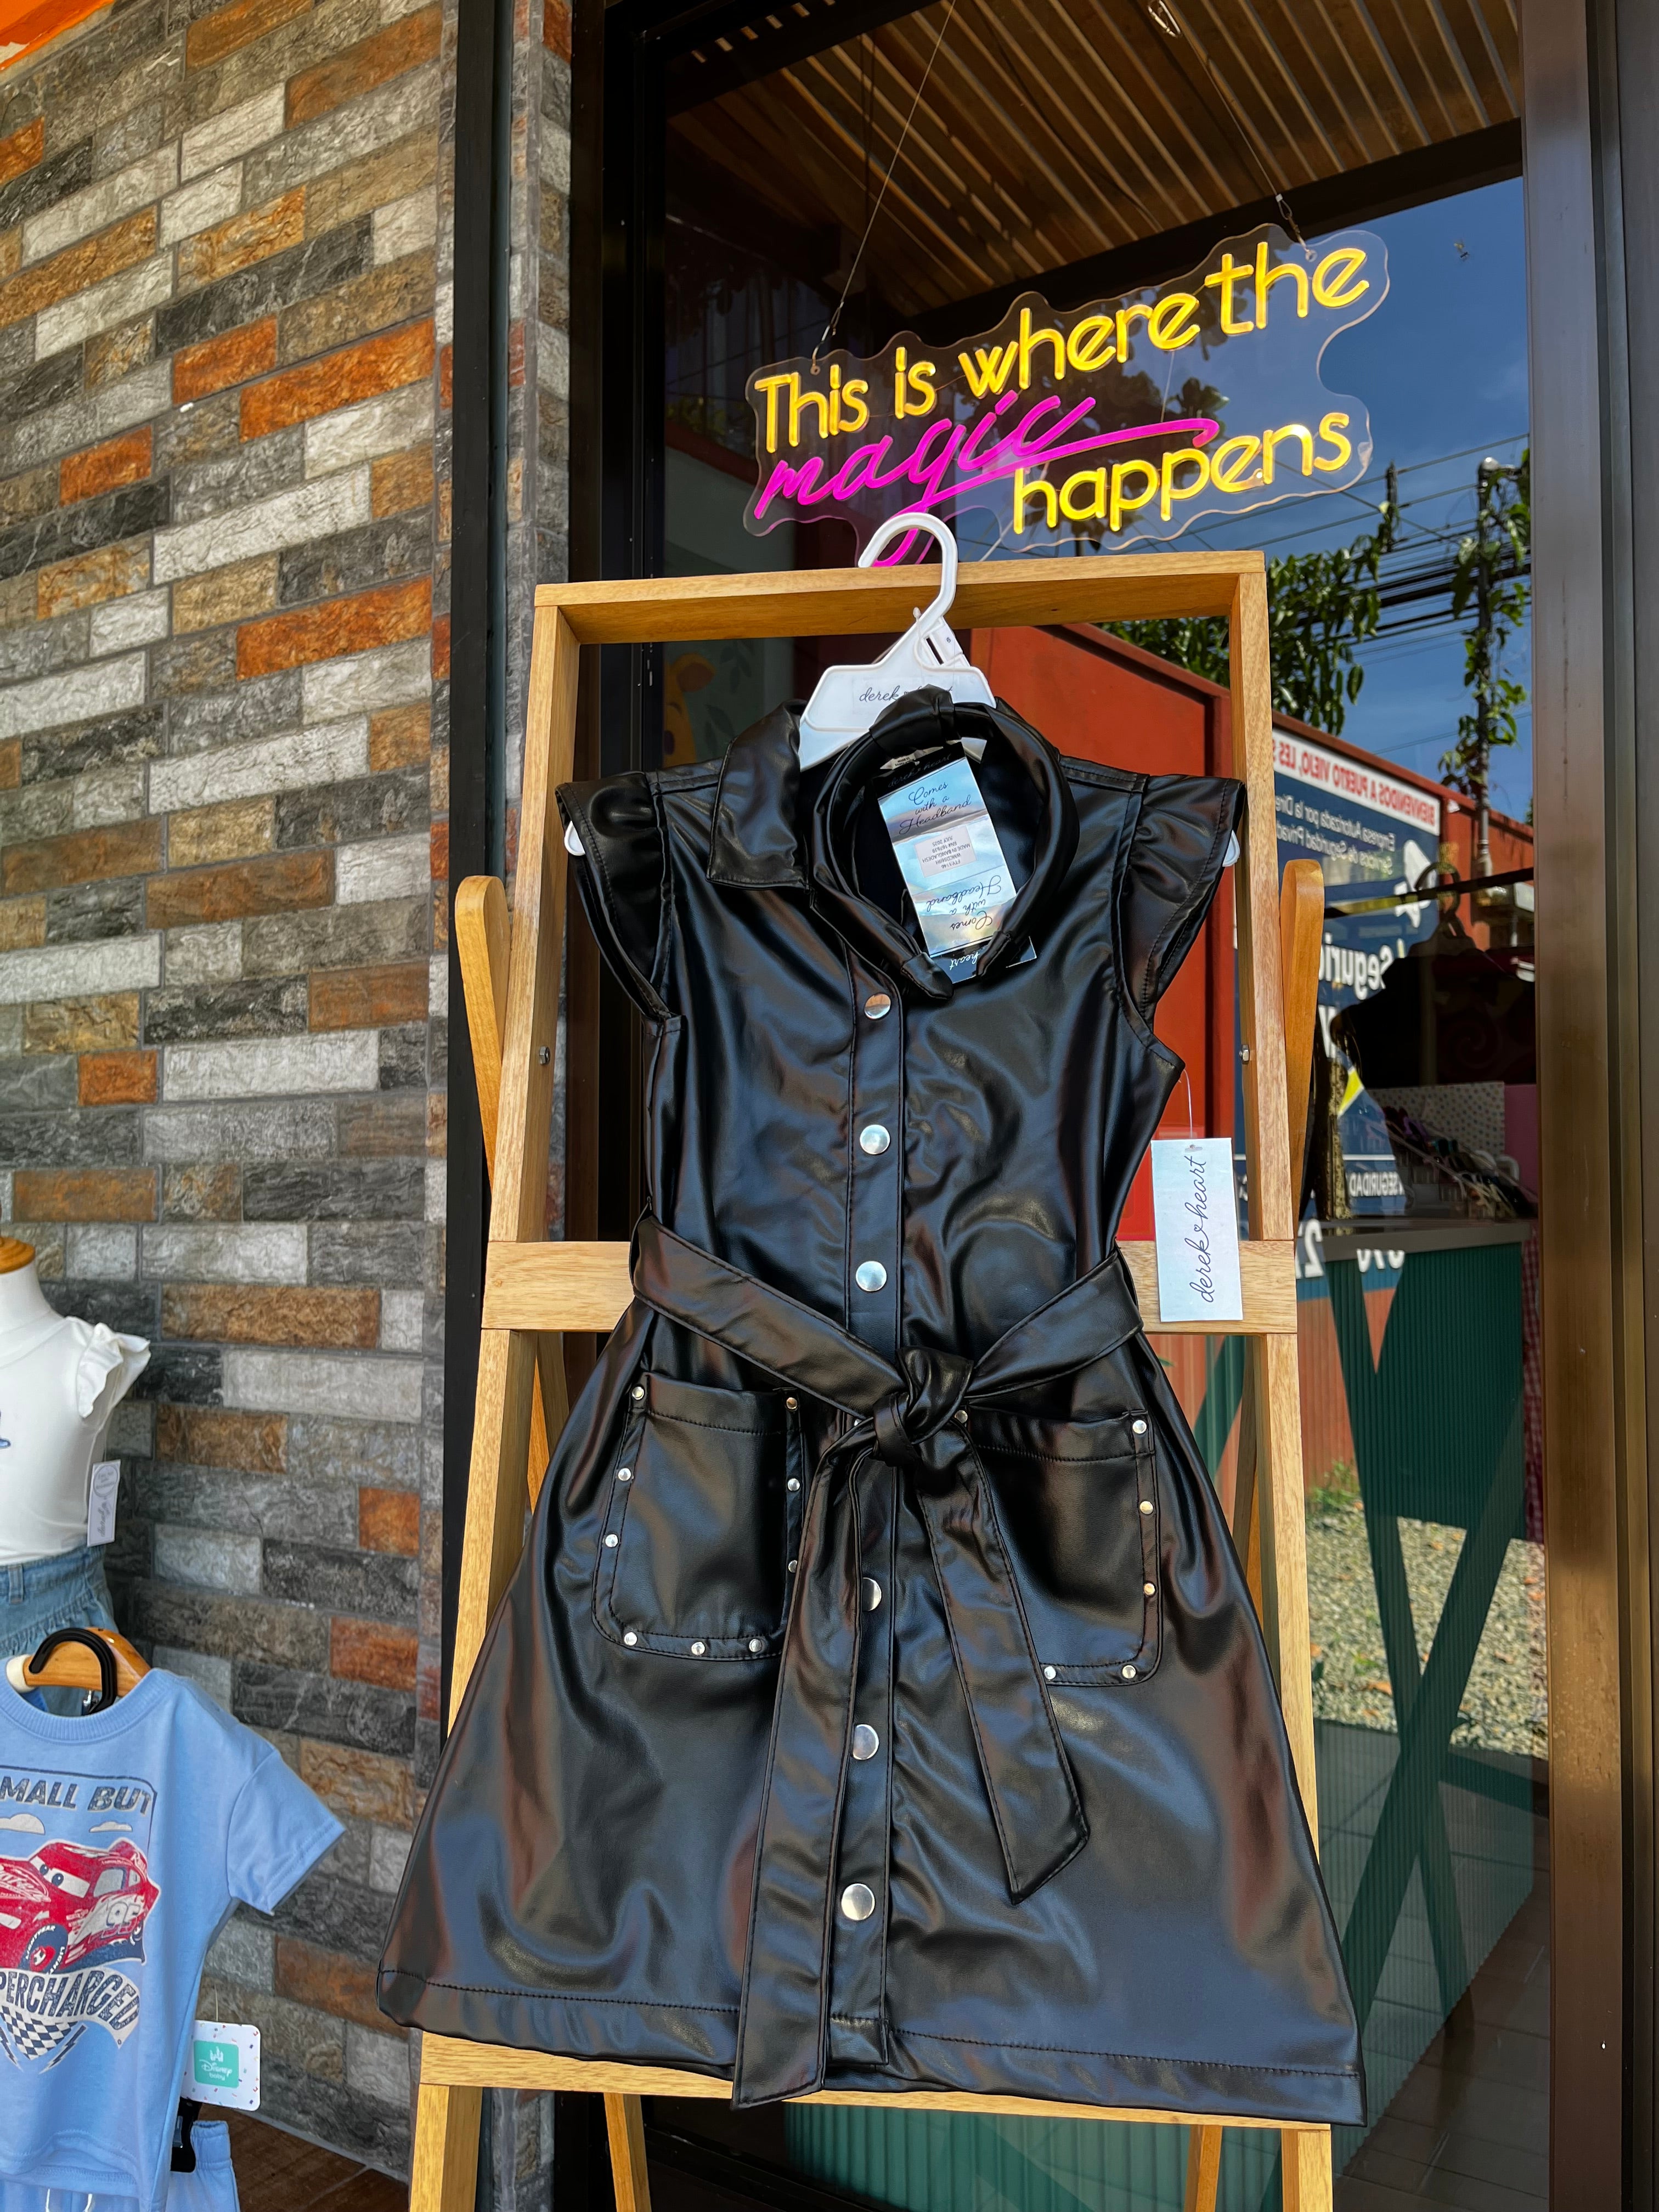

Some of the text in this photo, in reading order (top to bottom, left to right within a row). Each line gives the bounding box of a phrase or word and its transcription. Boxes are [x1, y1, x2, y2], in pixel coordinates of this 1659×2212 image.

[755, 240, 1370, 453] This is where the
[754, 389, 1219, 567] magic
[1012, 411, 1352, 534] happens
[859, 685, 900, 702] derek
[908, 782, 949, 805] Comes
[899, 794, 972, 835] Headband
[915, 798, 937, 815] with
[922, 849, 952, 864] BANGLADESH
[926, 874, 1002, 912] Headband
[963, 899, 986, 916] with
[950, 911, 993, 930] Comes
[949, 952, 979, 970] heart
[87, 1786, 152, 1815] BUT
[199, 2059, 233, 2078] Disney
[209, 2072, 225, 2081] baby
